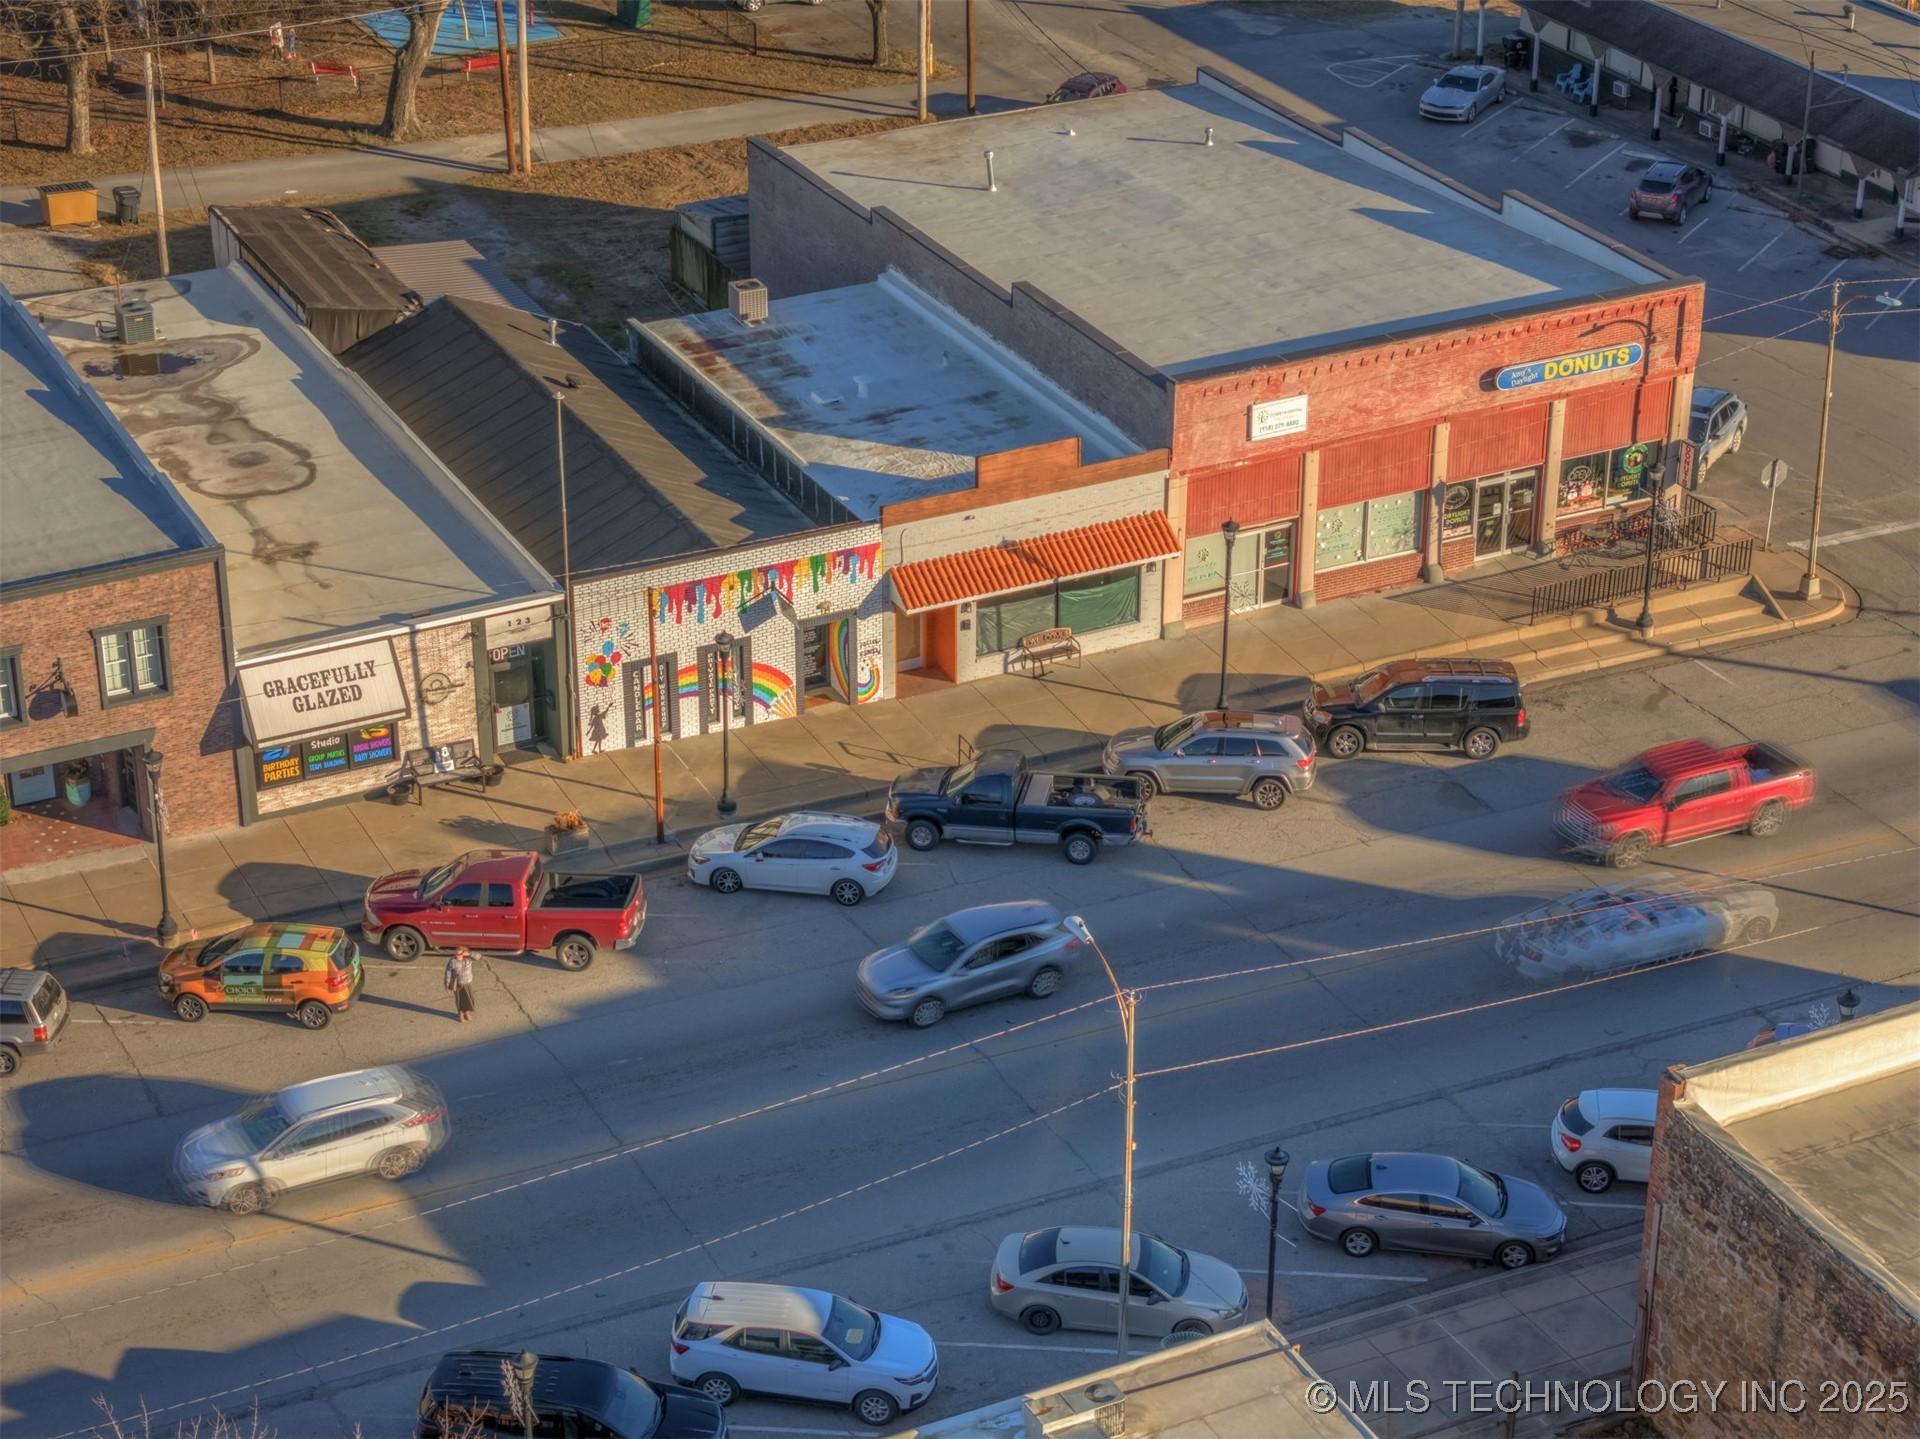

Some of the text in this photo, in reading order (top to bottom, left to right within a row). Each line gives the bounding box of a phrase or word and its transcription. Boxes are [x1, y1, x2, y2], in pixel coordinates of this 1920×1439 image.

[1544, 347, 1630, 380] DONUTS
[1510, 366, 1532, 380] Amy's
[1511, 373, 1539, 387] Daylight
[1681, 444, 1692, 487] DONUTS
[507, 617, 531, 627] 123
[492, 644, 525, 661] OPEN
[263, 660, 377, 698] GRACEFULLY
[292, 684, 363, 713] GLAZED
[632, 670, 643, 732] CANDLE BAR
[659, 683, 667, 728] WORKSHOP
[310, 736, 340, 750] Studio
[308, 749, 345, 763] GROUP PARTIES
[354, 746, 392, 763] BABY SHOWERS
[262, 757, 300, 773] BIRTHDAY
[309, 757, 346, 772] TEAM BUILDING
[263, 765, 301, 783] PARTIES
[225, 986, 256, 994] CHOICE
